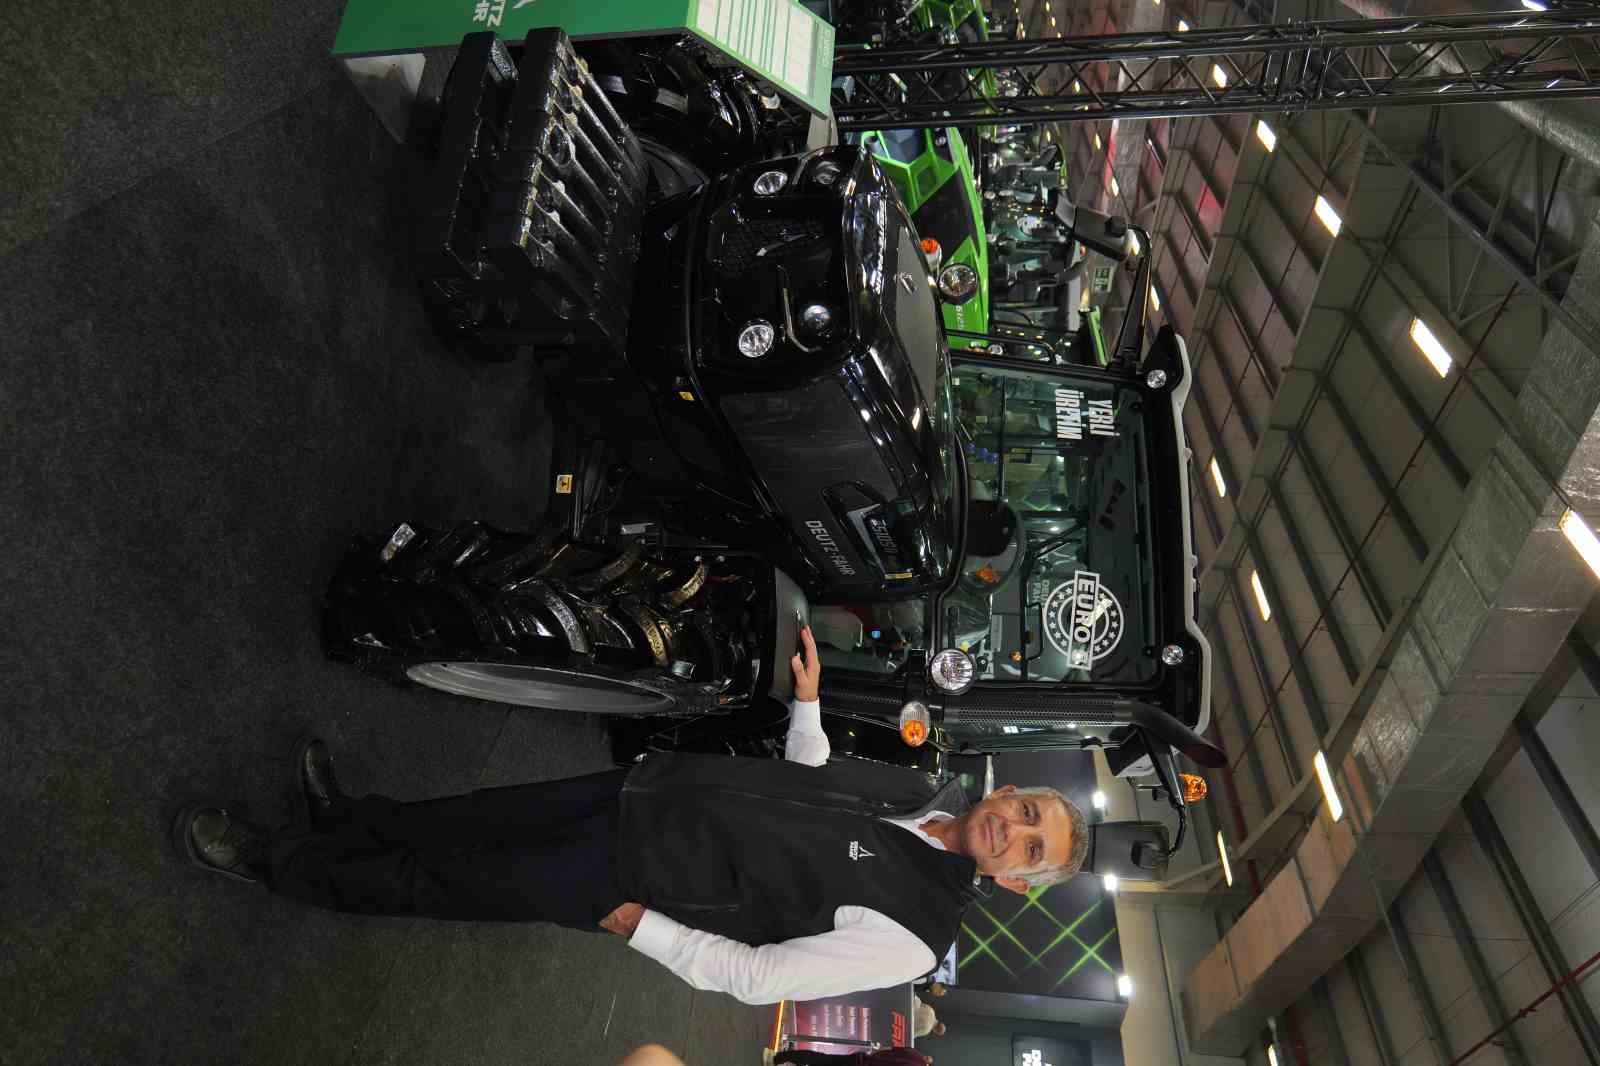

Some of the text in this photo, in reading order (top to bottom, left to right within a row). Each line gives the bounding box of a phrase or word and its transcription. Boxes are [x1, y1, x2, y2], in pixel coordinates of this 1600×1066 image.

[1055, 389, 1086, 440] ÜRETİM
[1088, 400, 1120, 436] YERLİ
[805, 520, 856, 575] DEUTZ-FAHR
[1073, 579, 1095, 643] EURO
